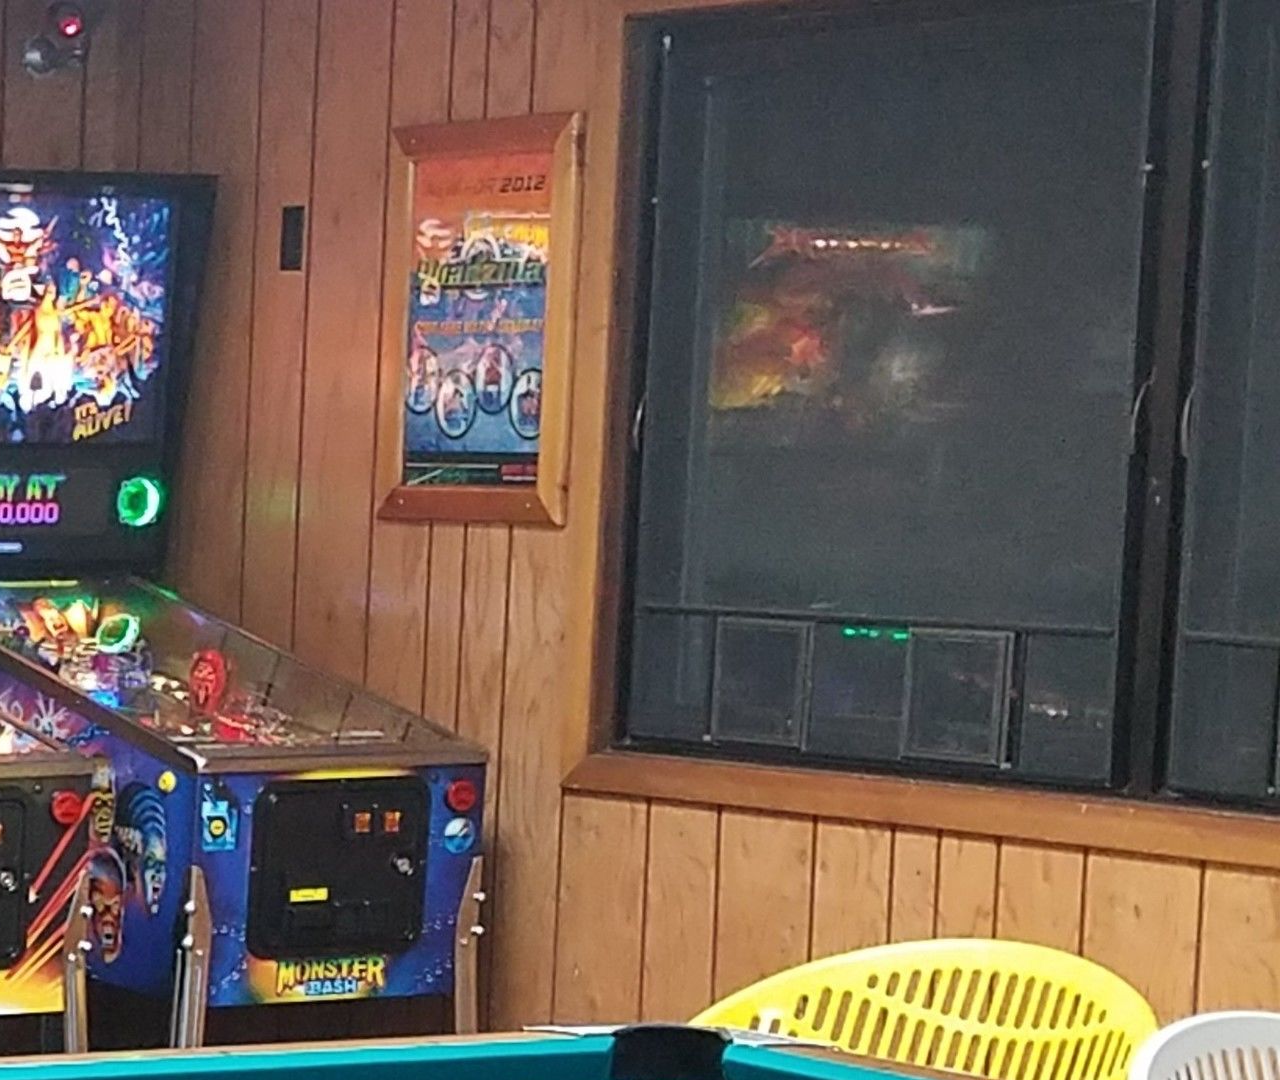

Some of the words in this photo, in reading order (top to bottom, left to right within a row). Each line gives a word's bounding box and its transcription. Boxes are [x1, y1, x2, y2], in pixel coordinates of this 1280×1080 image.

[499, 174, 546, 194] 2012
[26, 473, 67, 501] AT
[276, 956, 385, 997] MONSTER
[304, 979, 358, 996] BASH
